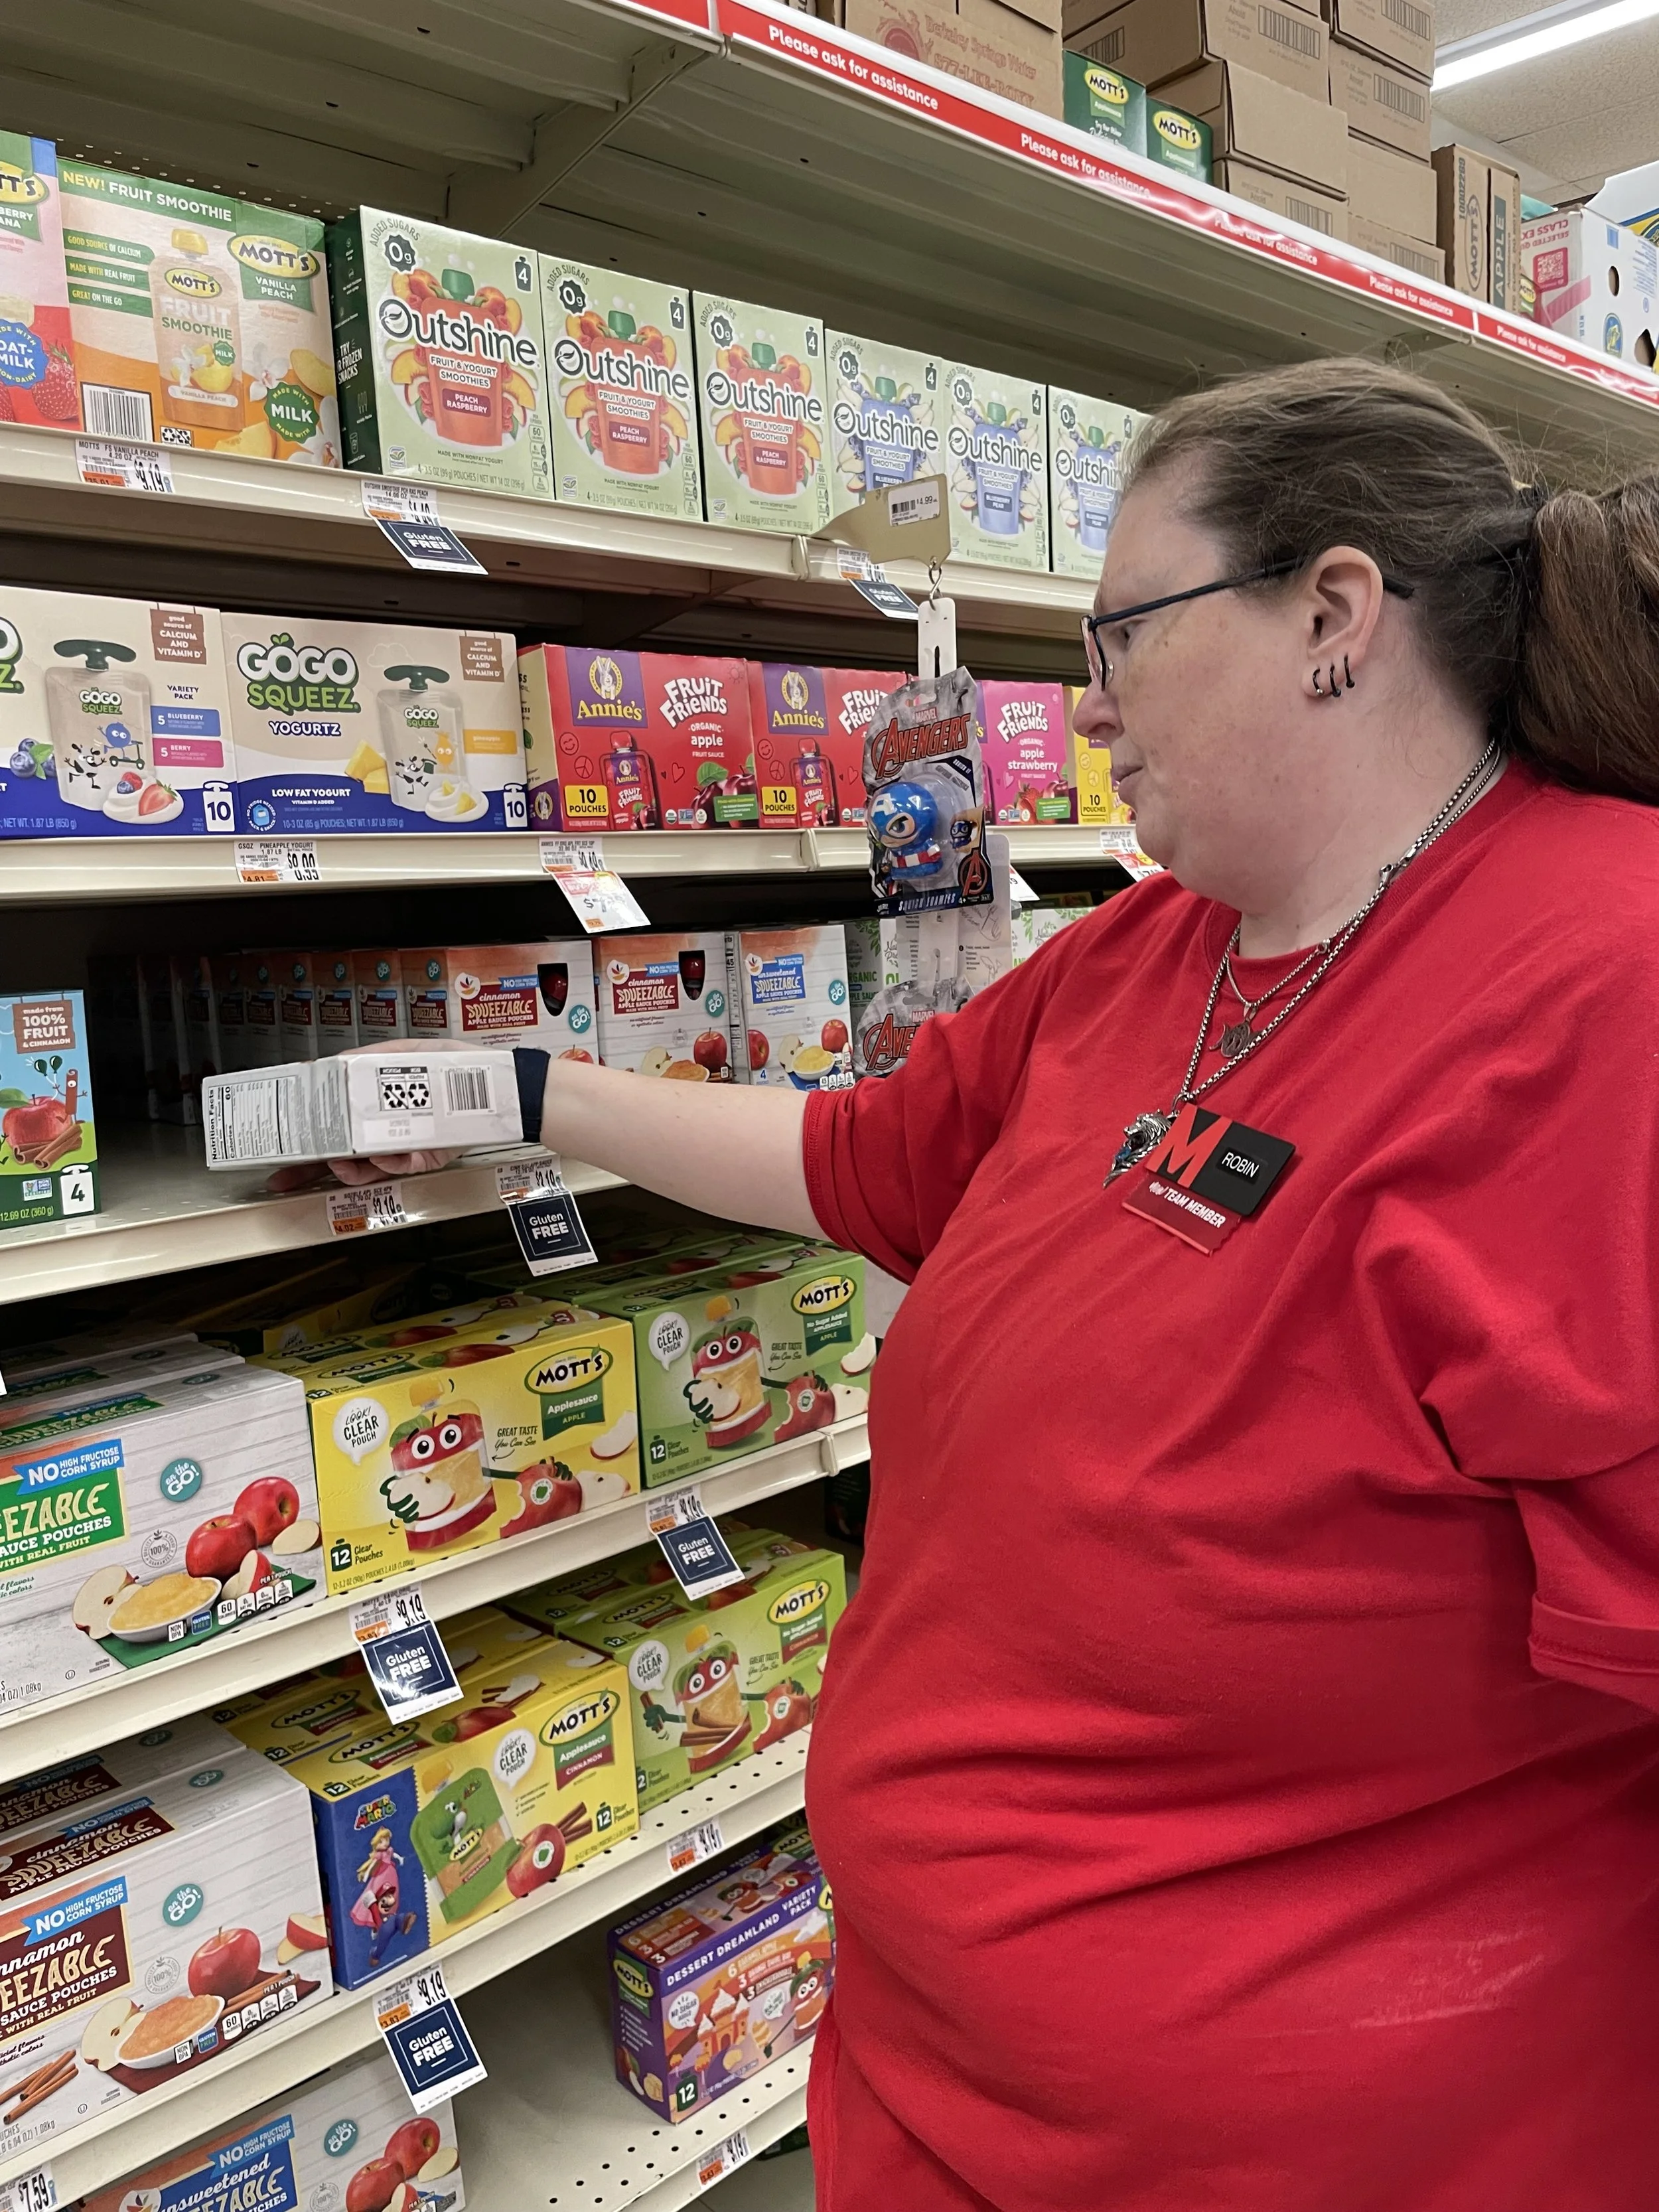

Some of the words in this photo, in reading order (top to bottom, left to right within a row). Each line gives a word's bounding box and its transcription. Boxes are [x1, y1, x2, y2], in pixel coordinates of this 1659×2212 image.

[768, 24, 818, 59] Please
[822, 49, 845, 70] ask
[849, 60, 868, 80] for
[871, 72, 939, 110] assistance
[1159, 114, 1197, 142] MOTT'S
[1021, 133, 1058, 163] Please
[1060, 154, 1079, 169] ask
[1082, 159, 1096, 177] for
[1098, 167, 1149, 198] assistance
[63, 171, 105, 192] NEW!
[109, 181, 152, 202] FRUIT
[157, 194, 232, 222] SMOOTHIE
[369, 220, 388, 247] ADDED
[388, 218, 421, 241] SUGARS
[1537, 220, 1568, 232] CLASS
[68, 236, 84, 246] GOOD
[85, 238, 108, 250] SOURCE
[109, 242, 115, 252] OF
[117, 244, 141, 258] CALCIUM
[239, 242, 310, 273] MOTT'S
[70, 263, 86, 274] MADE
[88, 265, 104, 275] WITH
[104, 268, 118, 279] REAL
[119, 271, 135, 283] FRUIT
[171, 274, 216, 293] MOTT'S
[518, 271, 529, 285] 4
[255, 276, 297, 293] VANILLA
[261, 287, 293, 301] PEACH
[72, 289, 90, 300] GREAT
[92, 293, 100, 302] ON
[102, 293, 113, 304] THE
[114, 296, 122, 306] GO
[1370, 276, 1392, 292] Please
[1394, 283, 1407, 298] ask
[1408, 287, 1419, 304] for
[1419, 292, 1453, 317] assistance
[161, 295, 231, 324] FRUIT
[162, 317, 232, 340] SMOOTHIE
[379, 299, 538, 367] Outshine
[215, 348, 234, 359] MILK
[431, 355, 456, 370] FRUIT
[464, 362, 496, 376] YOGURT
[555, 340, 690, 400] Outshine
[441, 370, 490, 388] SMOOTHIES
[447, 400, 487, 415] RASPBERRY
[455, 393, 478, 406] PEACH
[707, 372, 824, 423] Outshine
[271, 404, 313, 423] MILK
[834, 403, 939, 451] Outshine
[79, 441, 100, 450] MOTTS
[105, 444, 112, 453] FS
[113, 445, 139, 456] VANILLA
[139, 449, 159, 459] PEACH
[948, 427, 1043, 472] Outshine
[134, 460, 165, 493] $9.19
[159, 630, 198, 640] CALCIUM
[170, 640, 188, 648] AND
[157, 648, 193, 657] VITAMIN
[238, 642, 359, 686] GOGO
[167, 685, 199, 694] VARIETY
[664, 677, 723, 700] FRUIT
[158, 715, 165, 725] 5
[577, 700, 642, 721] Annie's
[660, 696, 727, 728] FRIENDS
[772, 710, 825, 729] Annie's
[915, 708, 937, 722] MARVEL
[1001, 701, 1046, 720] FRUIT
[269, 721, 341, 736] YOGURTZ
[690, 723, 721, 733] ORGANIC
[161, 747, 168, 757] 5
[691, 735, 723, 749] apple
[875, 713, 971, 779] AVENGERS
[1020, 748, 1045, 760] apple
[1007, 759, 1058, 773] strawberry
[579, 789, 597, 803] 10
[1089, 794, 1100, 806] 10
[207, 801, 231, 820] 10
[507, 800, 525, 818] 10
[569, 804, 607, 814] POUCHES
[503, 977, 516, 988] NO
[479, 991, 521, 1001] cinnamon
[23, 1014, 66, 1027] 100%
[467, 999, 534, 1021] SQUEEZABLE
[23, 1025, 68, 1039] FRUIT
[225, 1086, 231, 1100] 60
[209, 1118, 218, 1160] Nutrition
[1145, 1103, 1233, 1189] M
[1222, 1152, 1259, 1178] ROBIN
[71, 1183, 85, 1202] 4
[1164, 1189, 1189, 1207] TEAM
[1186, 1200, 1226, 1228] MEMBER
[530, 1213, 564, 1227] Gluten
[532, 1222, 569, 1240] FREE
[799, 1282, 850, 1309] MOTT'S
[656, 1327, 684, 1349] CLEAR
[536, 1354, 603, 1387] MOTT'S
[547, 1393, 598, 1415] Applesauce
[345, 1406, 371, 1426] LOOK!
[343, 1416, 379, 1441] CLEAR
[351, 1432, 377, 1447] POUCH
[60, 1455, 80, 1470] HIGH
[80, 1447, 119, 1465] FRUCTOSE
[60, 1463, 89, 1477] CORN
[90, 1456, 119, 1471] SYRUP
[28, 1462, 60, 1486] NO
[167, 1466, 200, 1497] GO!
[43, 1516, 112, 1542] POUCHES
[27, 1545, 56, 1562] REAL
[60, 1536, 90, 1552] FRUIT
[678, 1536, 708, 1554] Gluten
[682, 1544, 715, 1566] FREE
[332, 1550, 350, 1566] 12
[396, 1594, 425, 1626] $9.19
[775, 1585, 824, 1619] MOTT'S
[386, 1645, 426, 1667] Gluten
[389, 1656, 432, 1681] FREE
[548, 1696, 611, 1739] MOTT'S
[560, 1733, 607, 1763] Applesauce
[565, 1753, 603, 1776] CINNAMON
[597, 1812, 611, 1828] 12
[66, 1900, 85, 1915] HIGH
[86, 1883, 123, 1907] FRUCTOSE
[66, 1909, 93, 1921] CORN
[94, 1893, 124, 1913] SYRUP
[781, 1885, 818, 1913] VARIETY
[790, 1899, 812, 1917] PACK
[35, 1911, 66, 1935] NO
[666, 1950, 715, 1987] DESSERT
[717, 1913, 780, 1958] DREAMLAND
[50, 1966, 117, 2003] POUCHES
[417, 1979, 448, 2006] $9.19
[408, 2025, 448, 2052] Gluten
[413, 2037, 455, 2068] FREE
[680, 2082, 696, 2104] 12
[219, 2146, 243, 2168] NO
[19, 2176, 49, 2211] $7.59
